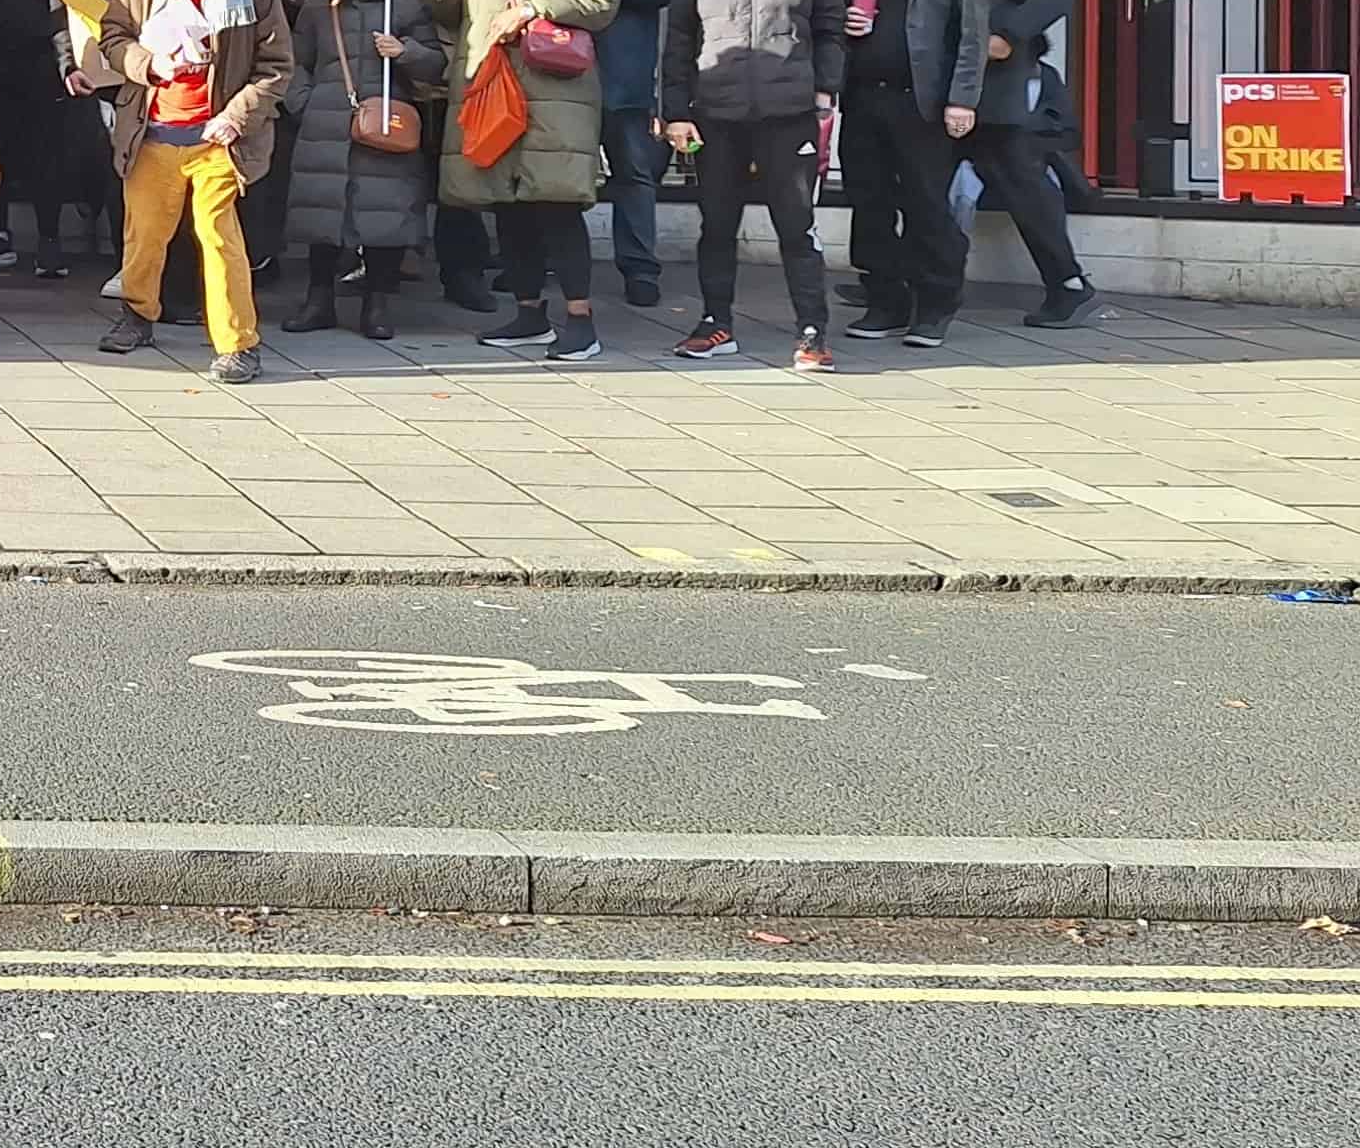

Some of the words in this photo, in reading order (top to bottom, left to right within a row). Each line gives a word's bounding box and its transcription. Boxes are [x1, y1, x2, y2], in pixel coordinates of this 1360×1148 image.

[1222, 83, 1277, 106] pcs
[1224, 124, 1279, 148] ON
[1224, 147, 1345, 172] STRIKE
